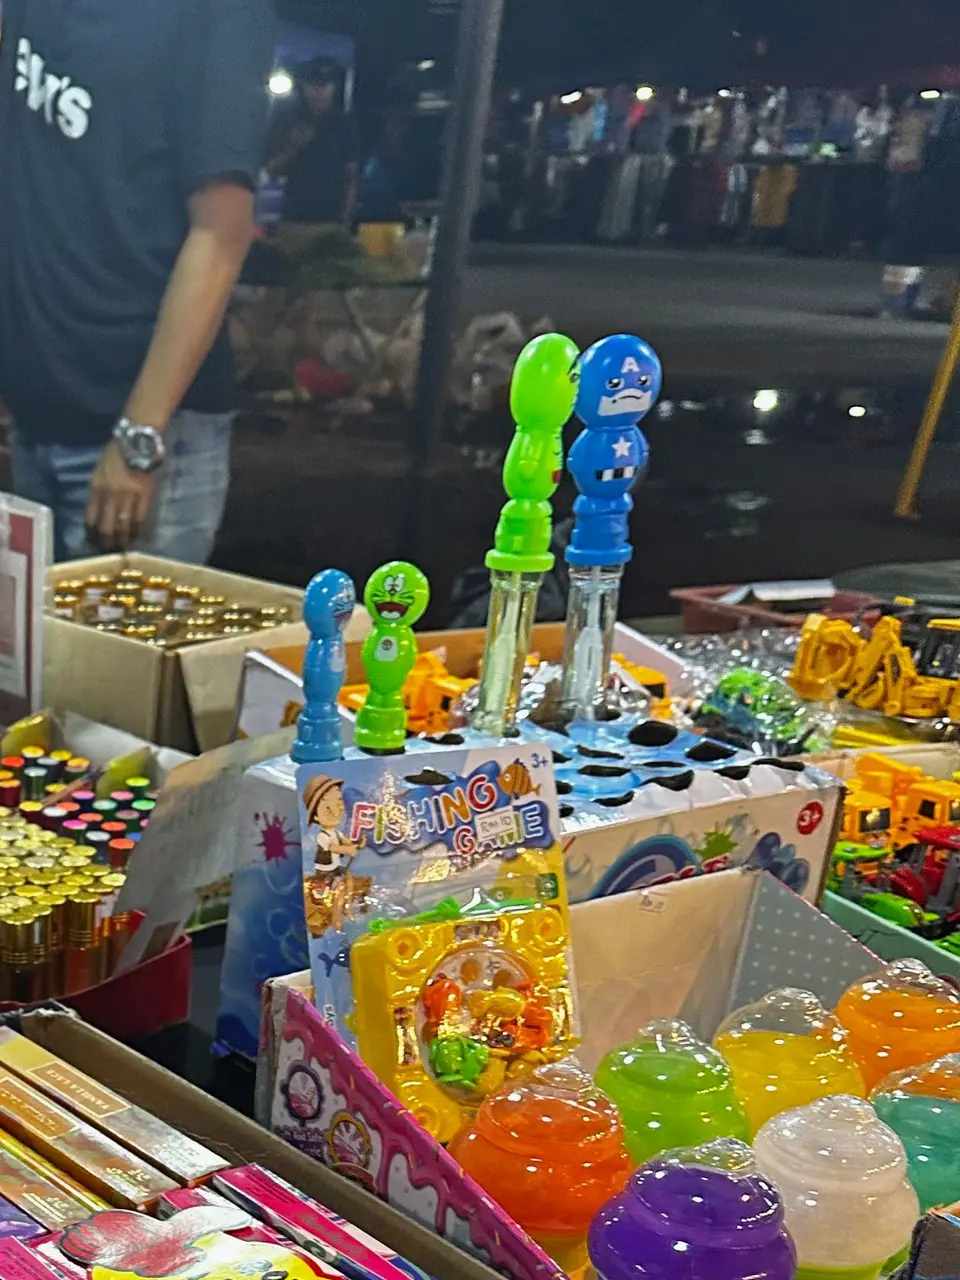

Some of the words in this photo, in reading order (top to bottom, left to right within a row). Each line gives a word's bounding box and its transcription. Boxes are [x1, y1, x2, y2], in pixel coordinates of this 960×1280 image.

[531, 753, 548, 768] 3+
[348, 774, 499, 845] FISHING
[799, 809, 820, 826] 3+
[453, 804, 543, 855] GME
